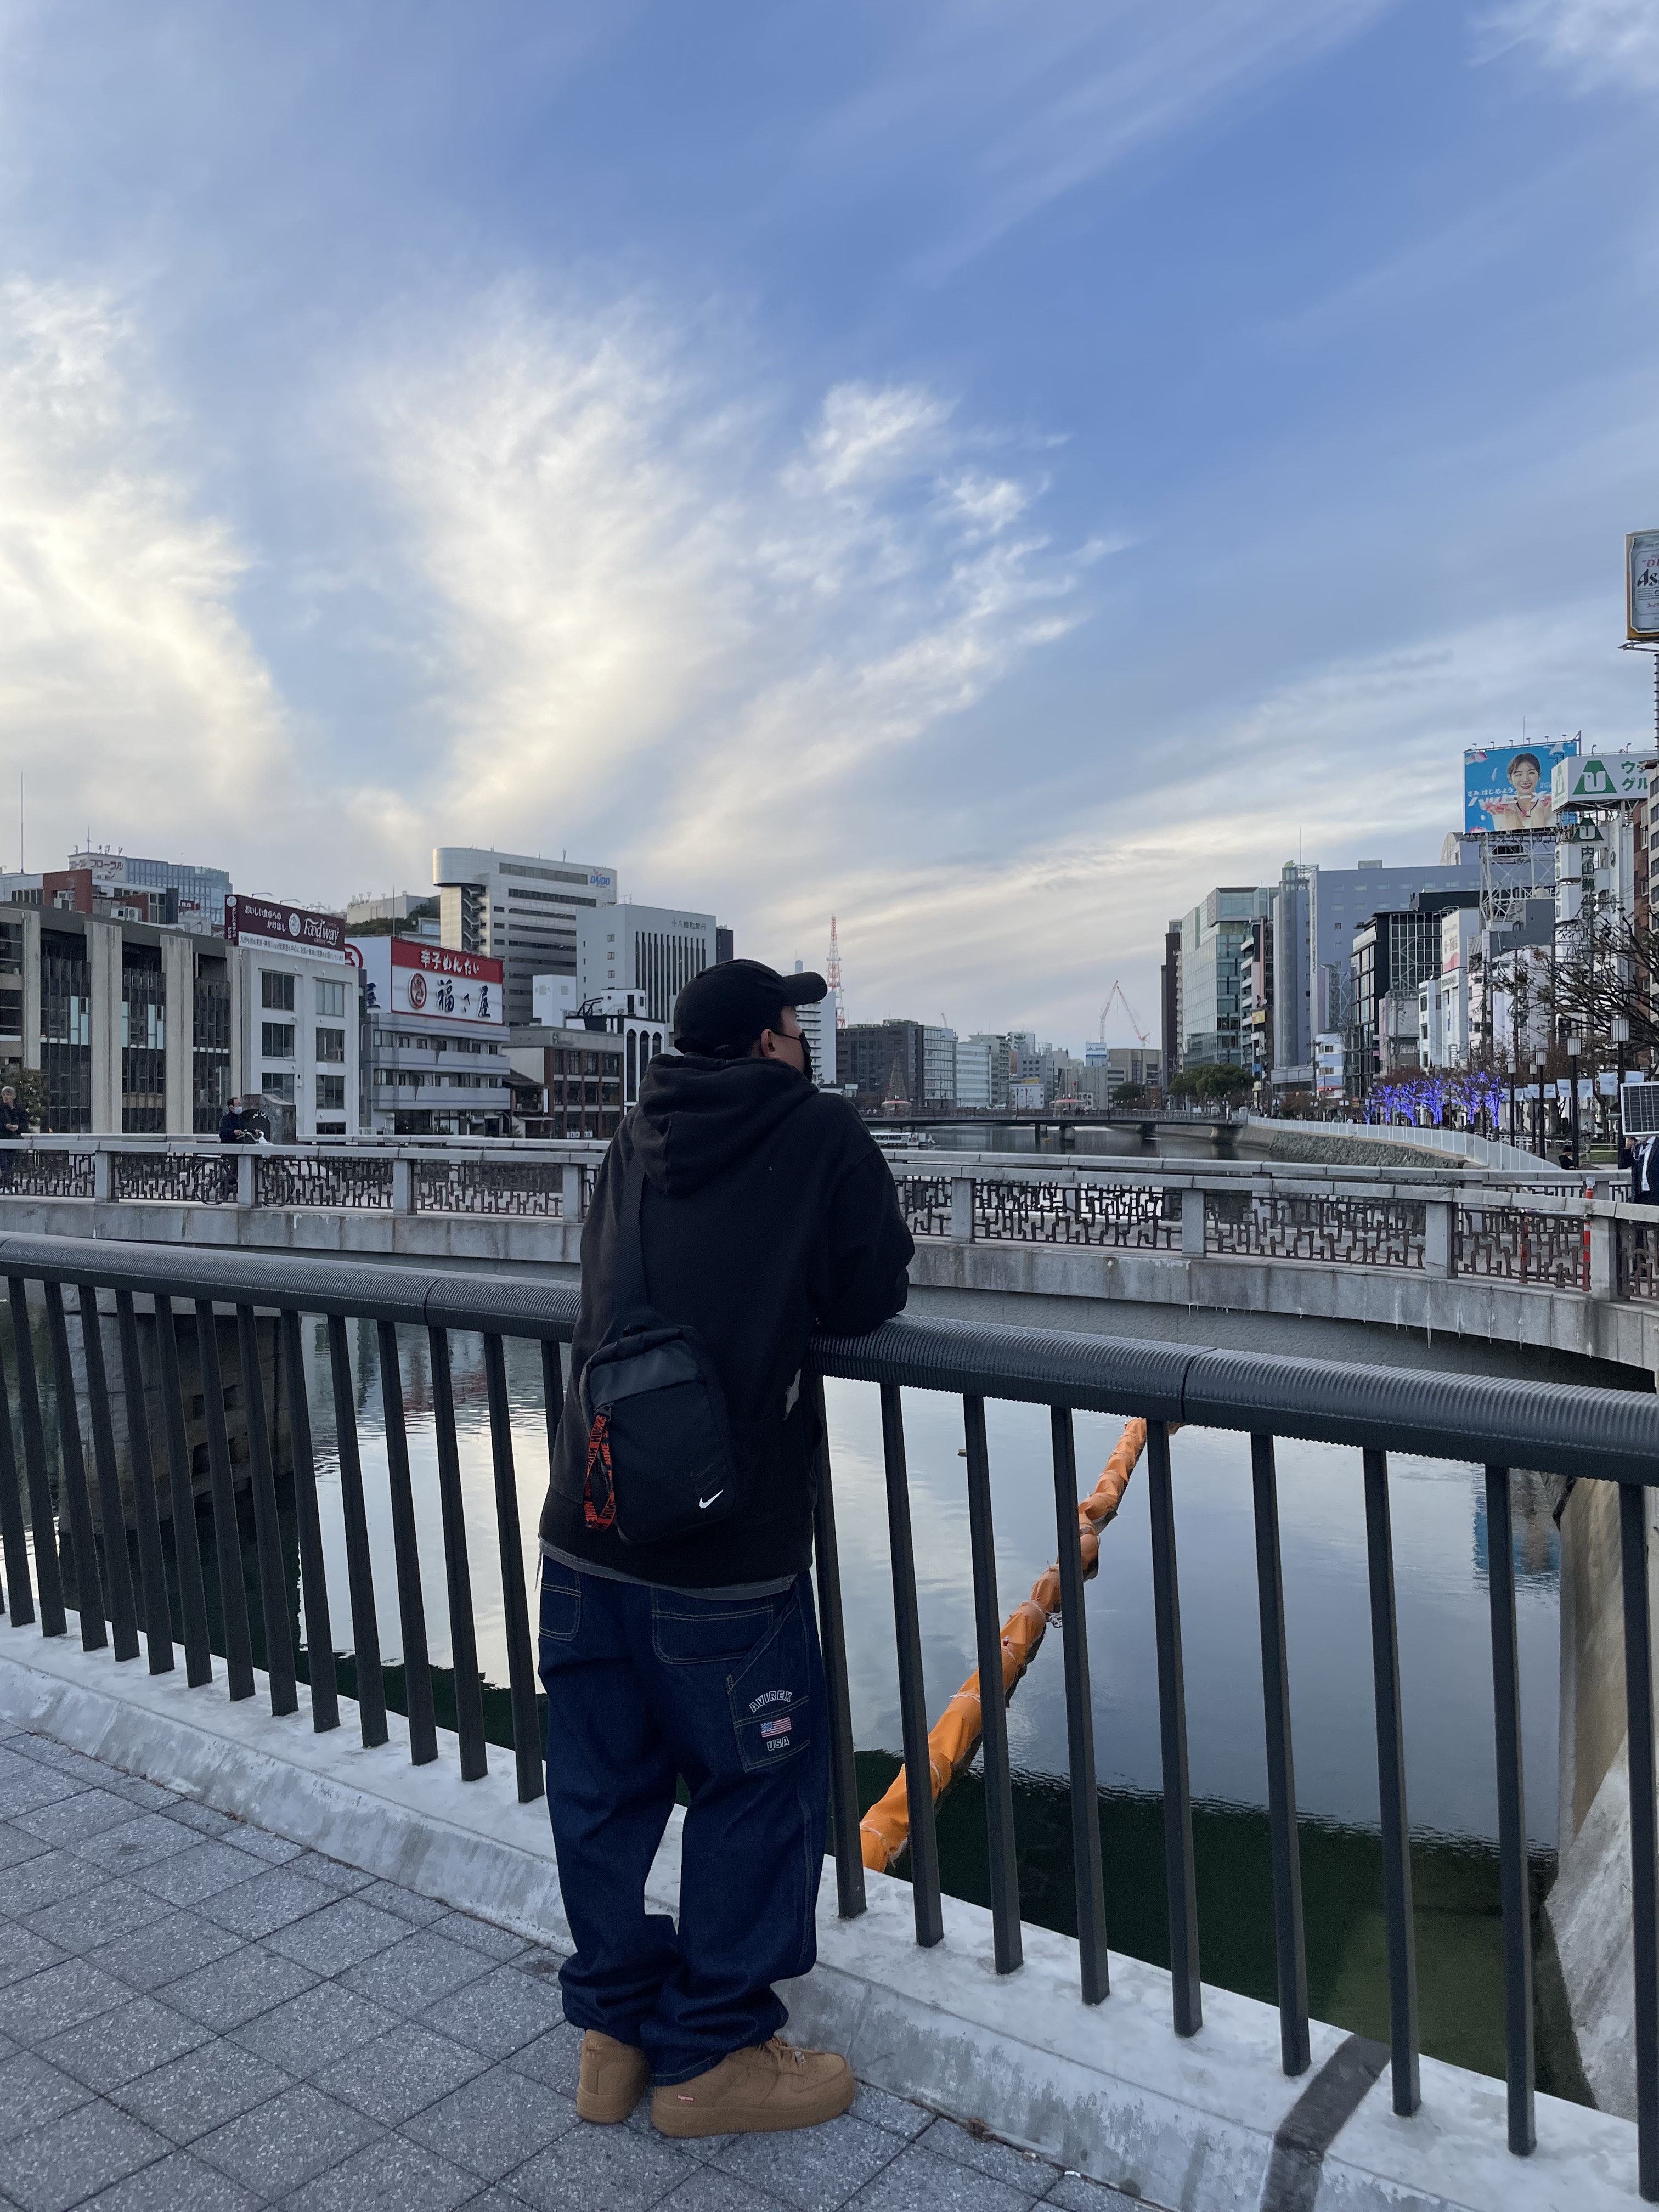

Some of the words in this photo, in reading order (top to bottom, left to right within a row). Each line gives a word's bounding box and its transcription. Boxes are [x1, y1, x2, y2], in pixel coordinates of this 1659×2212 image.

[89, 859, 123, 870] フローラル
[590, 876, 610, 887] DAIDO
[421, 949, 479, 975] 辛子めんたい
[749, 1690, 792, 1713] AVIREX
[766, 1736, 790, 1751] USA
